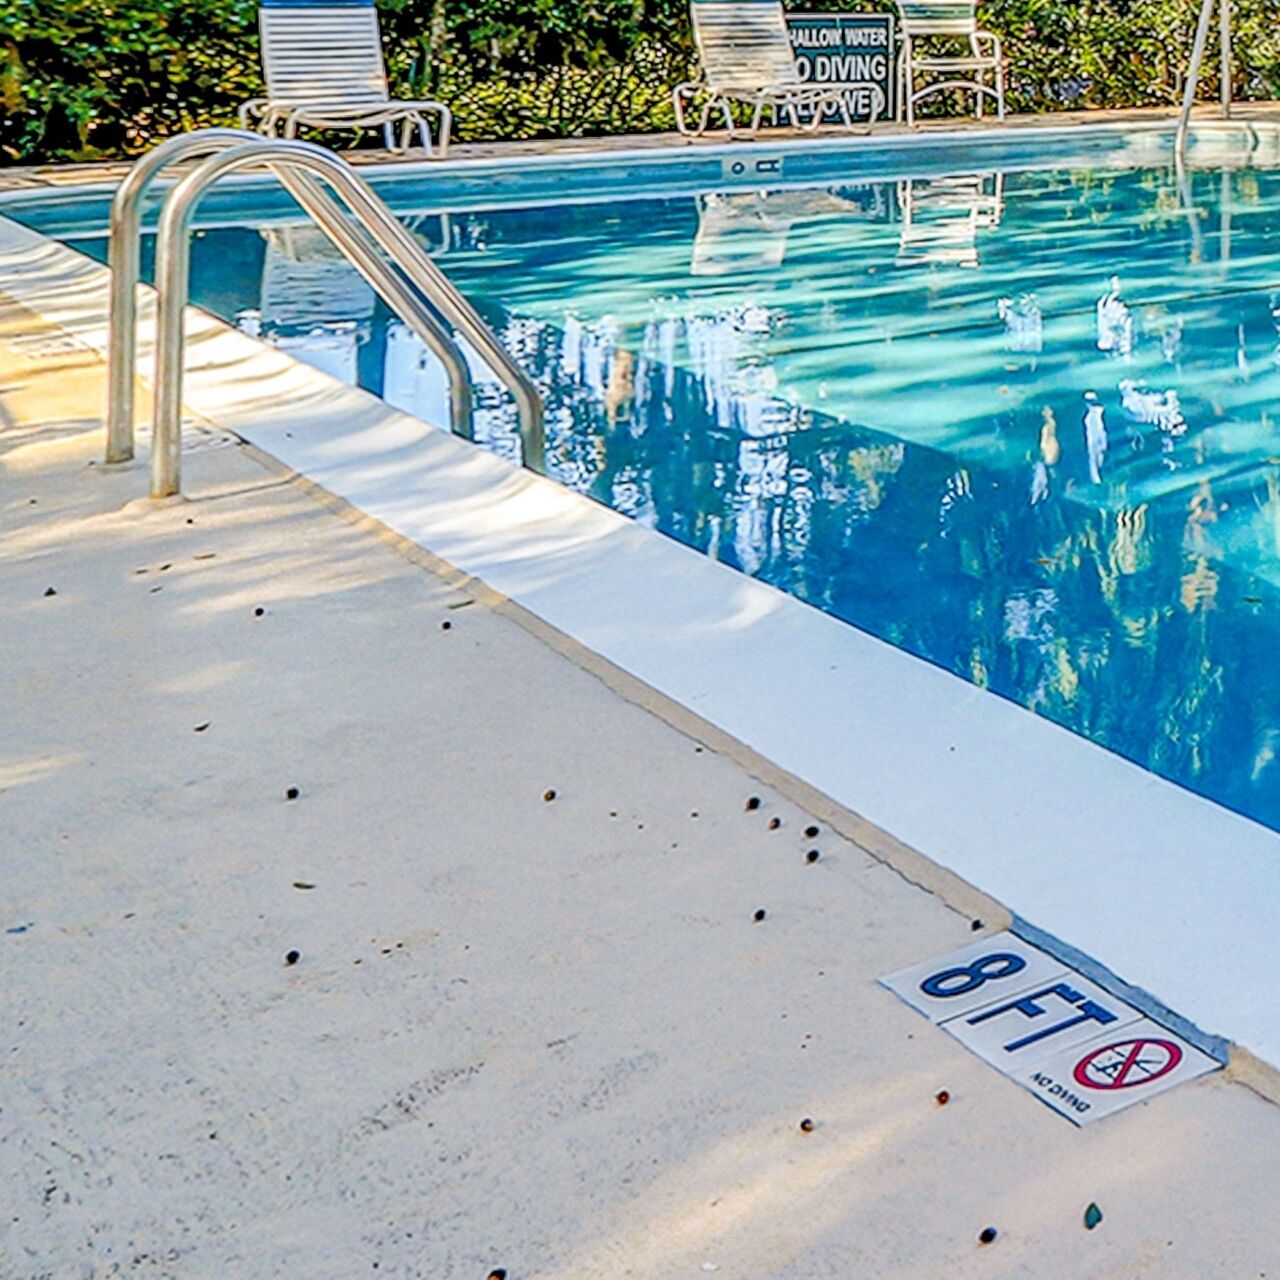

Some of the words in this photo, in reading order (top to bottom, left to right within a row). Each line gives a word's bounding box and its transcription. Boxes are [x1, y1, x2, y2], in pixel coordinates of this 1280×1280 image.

[788, 28, 842, 47] HALLOW
[845, 27, 887, 46] WATER
[795, 56, 811, 81] O
[815, 54, 887, 81] DIVING
[919, 952, 1027, 998] 8
[965, 982, 1119, 1053] FT
[1029, 1072, 1053, 1087] NO
[1048, 1084, 1091, 1113] DIVING
